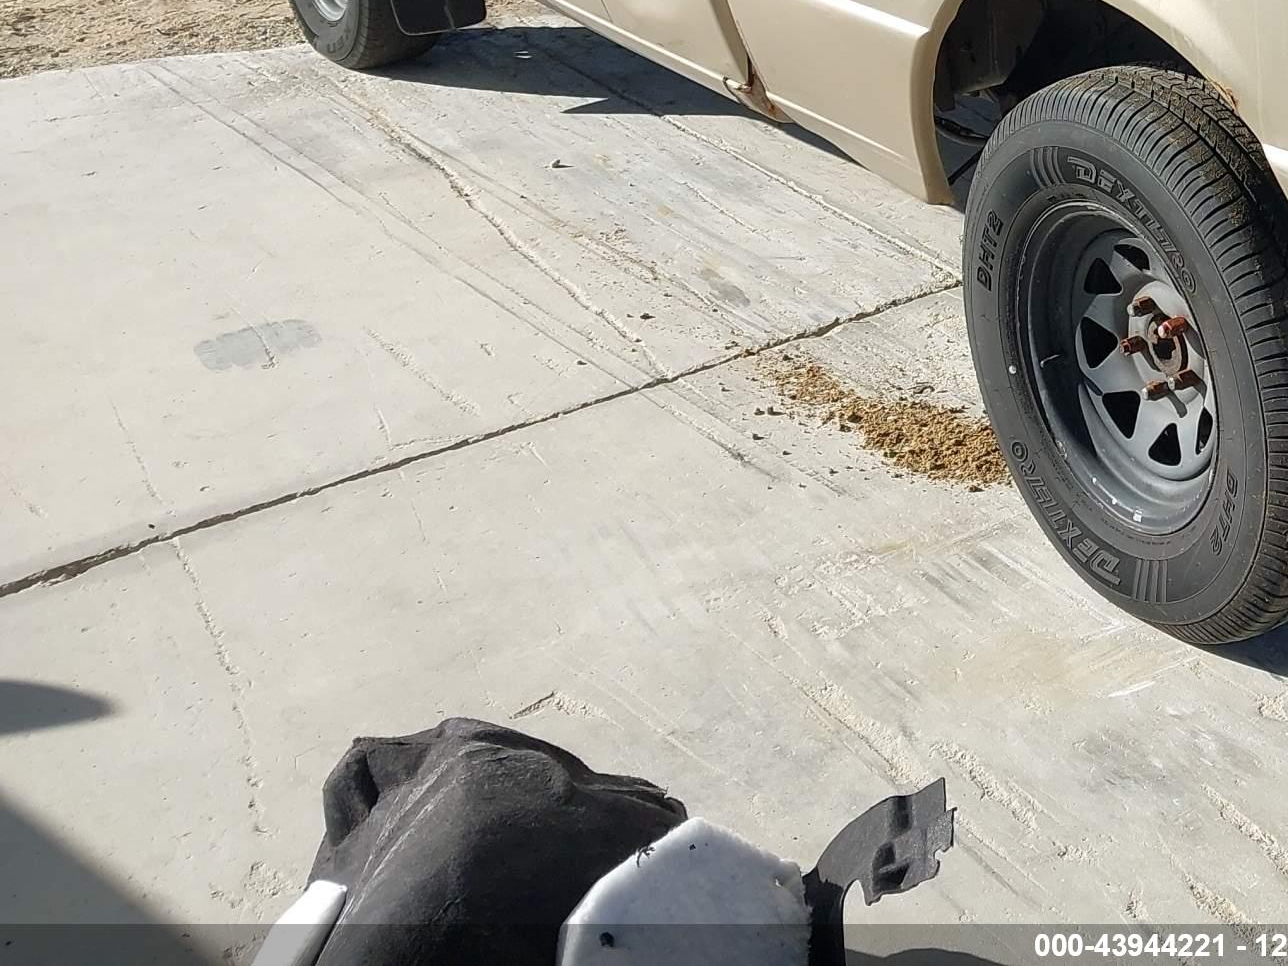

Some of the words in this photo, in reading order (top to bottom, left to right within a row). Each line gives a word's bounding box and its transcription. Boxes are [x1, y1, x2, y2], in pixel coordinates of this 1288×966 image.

[976, 208, 1004, 292] DHT2
[1066, 155, 1197, 295] DEXTERO
[1010, 440, 1122, 586] DEXTERO
[1210, 466, 1239, 556] DHT2
